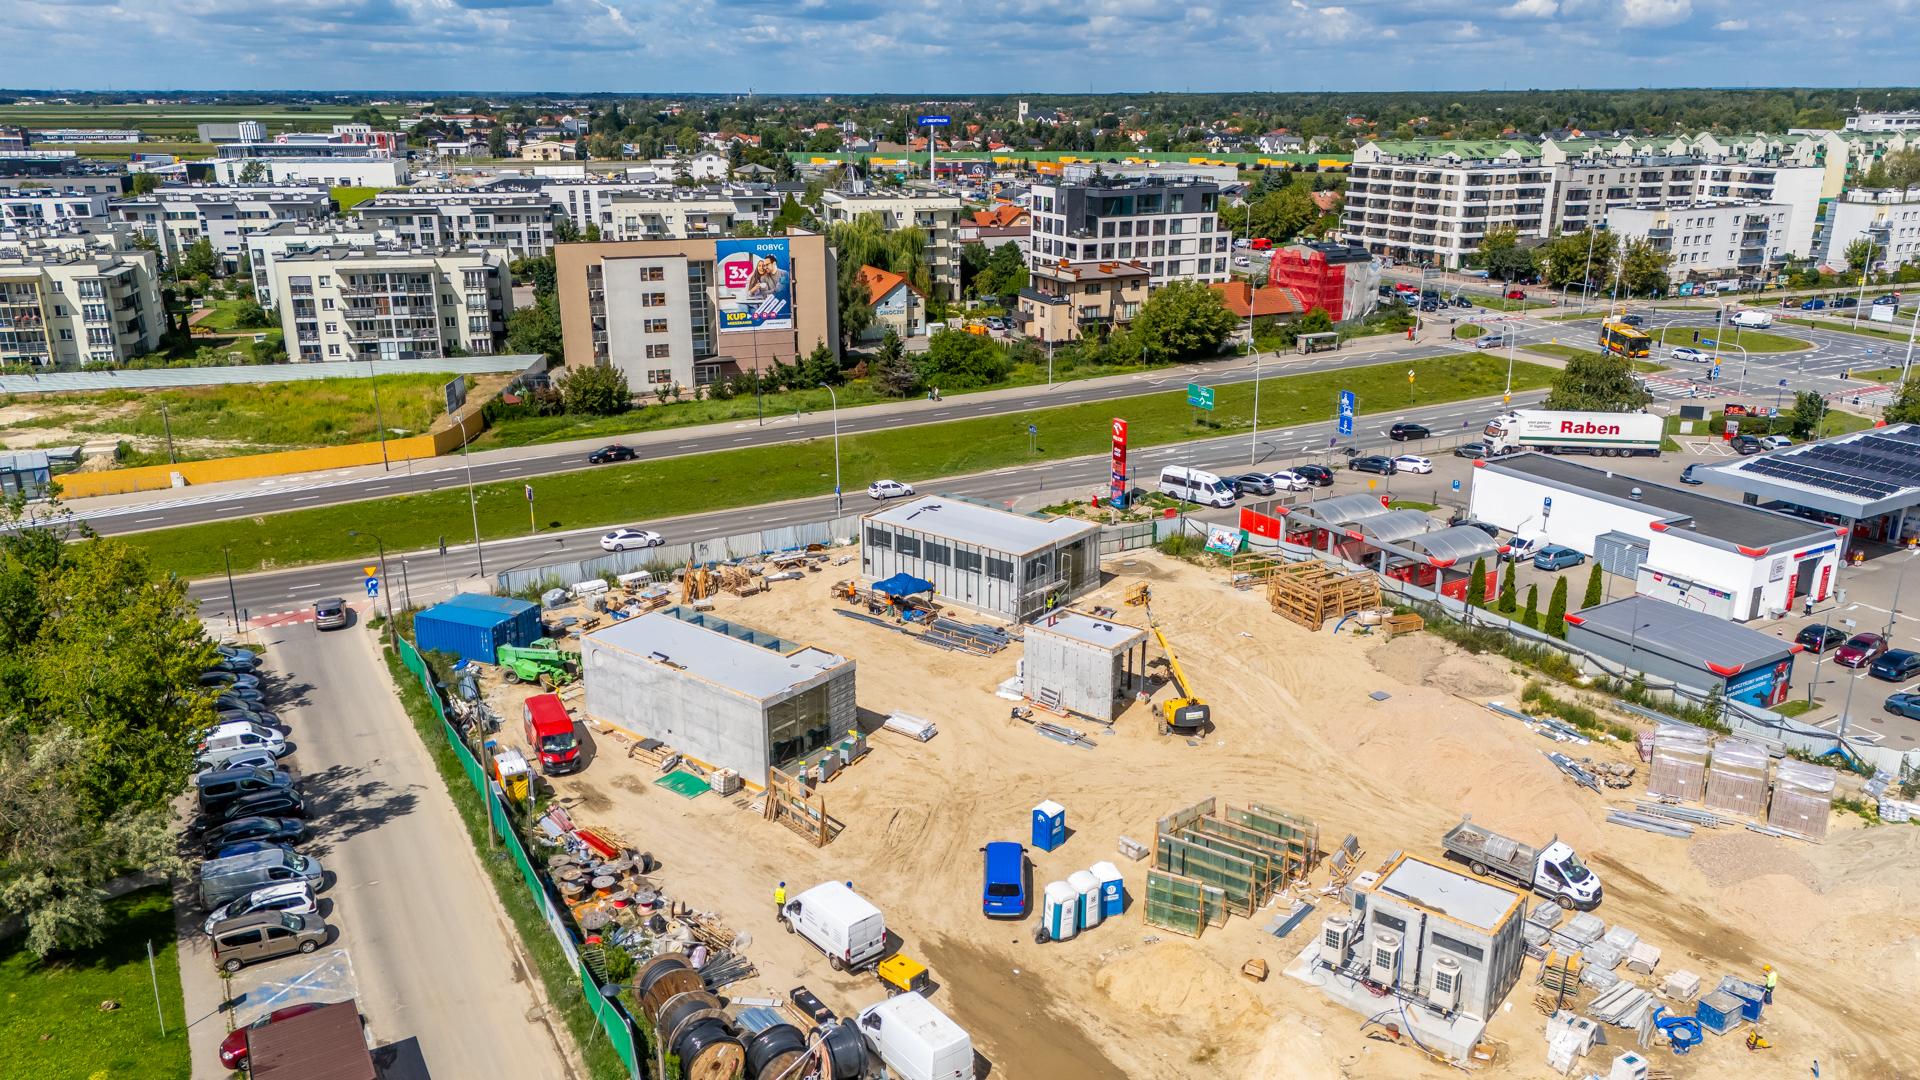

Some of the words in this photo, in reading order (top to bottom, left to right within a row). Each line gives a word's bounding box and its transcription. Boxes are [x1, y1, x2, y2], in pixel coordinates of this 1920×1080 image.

[729, 266, 748, 279] 3x
[726, 312, 747, 321] KUP
[1560, 420, 1620, 434] Raben
